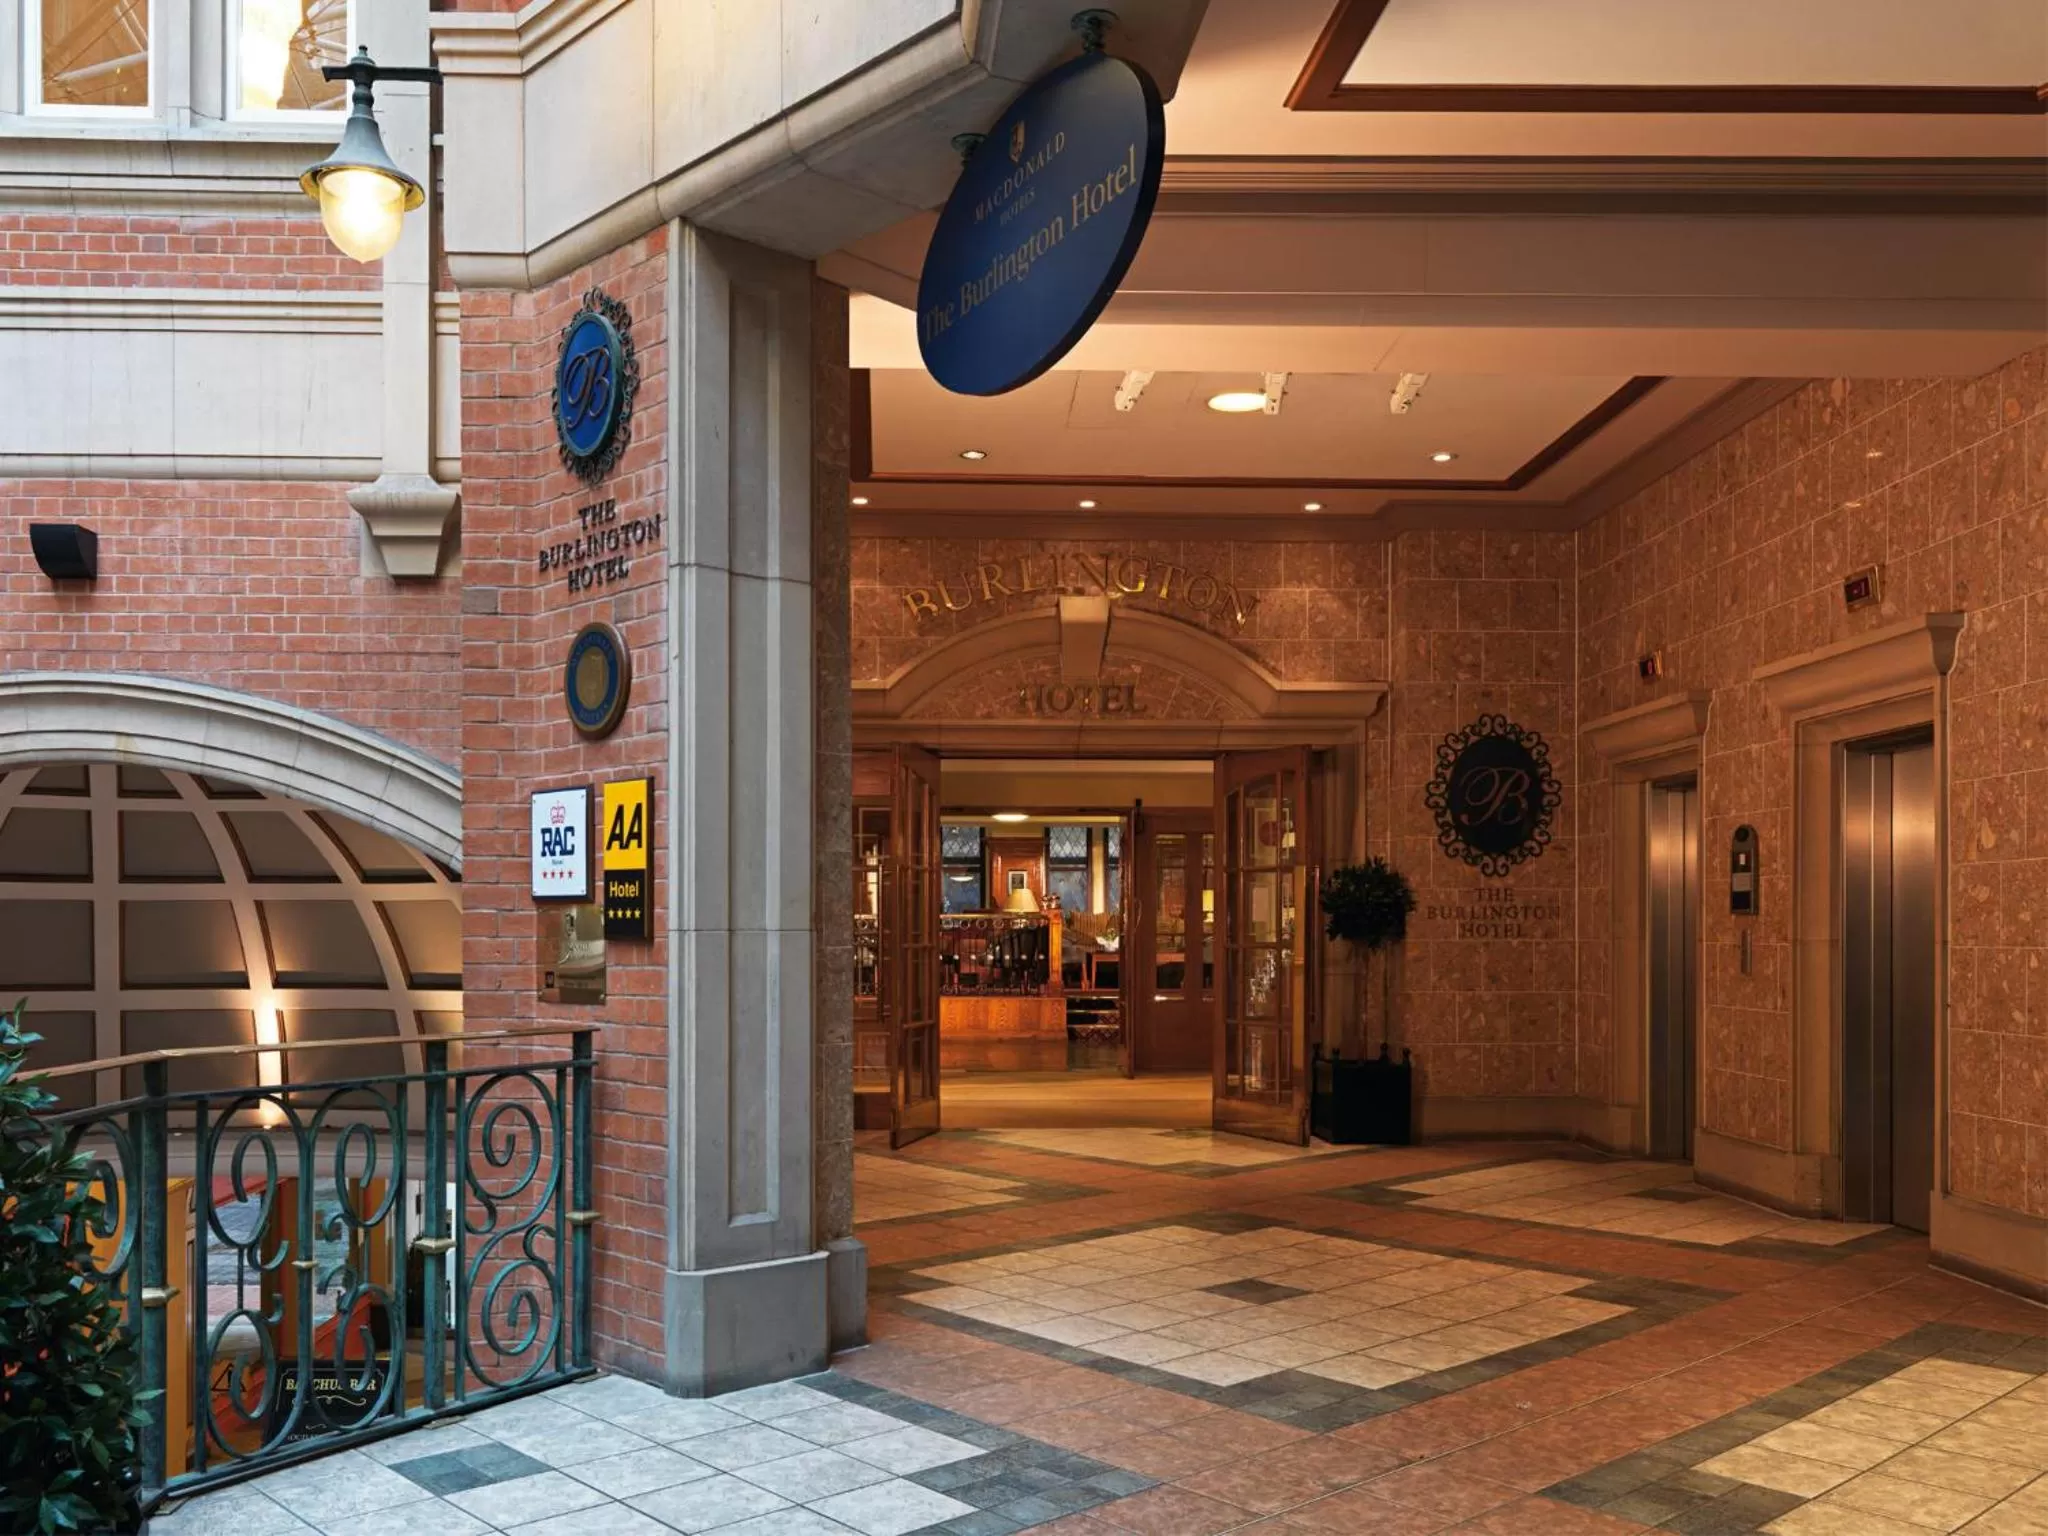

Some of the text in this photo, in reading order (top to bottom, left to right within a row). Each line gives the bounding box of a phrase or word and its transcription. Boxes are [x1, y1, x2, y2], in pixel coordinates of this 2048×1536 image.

[973, 131, 1065, 225] MACDONALD
[998, 190, 1036, 227] HOTELS
[922, 143, 1137, 344] The Burlington Hotel
[578, 499, 616, 532] THE
[539, 514, 661, 573] BURLINGTON
[567, 555, 630, 594] HOTEL
[902, 551, 1260, 633] BURLINGTON
[1018, 683, 1148, 714] HOTEL
[540, 826, 576, 857] RAC
[605, 802, 643, 851] AA
[609, 880, 640, 899] Hotel
[1476, 888, 1515, 902] THE
[1426, 905, 1561, 921] BURLINGTON
[1461, 923, 1524, 939] HOTEL
